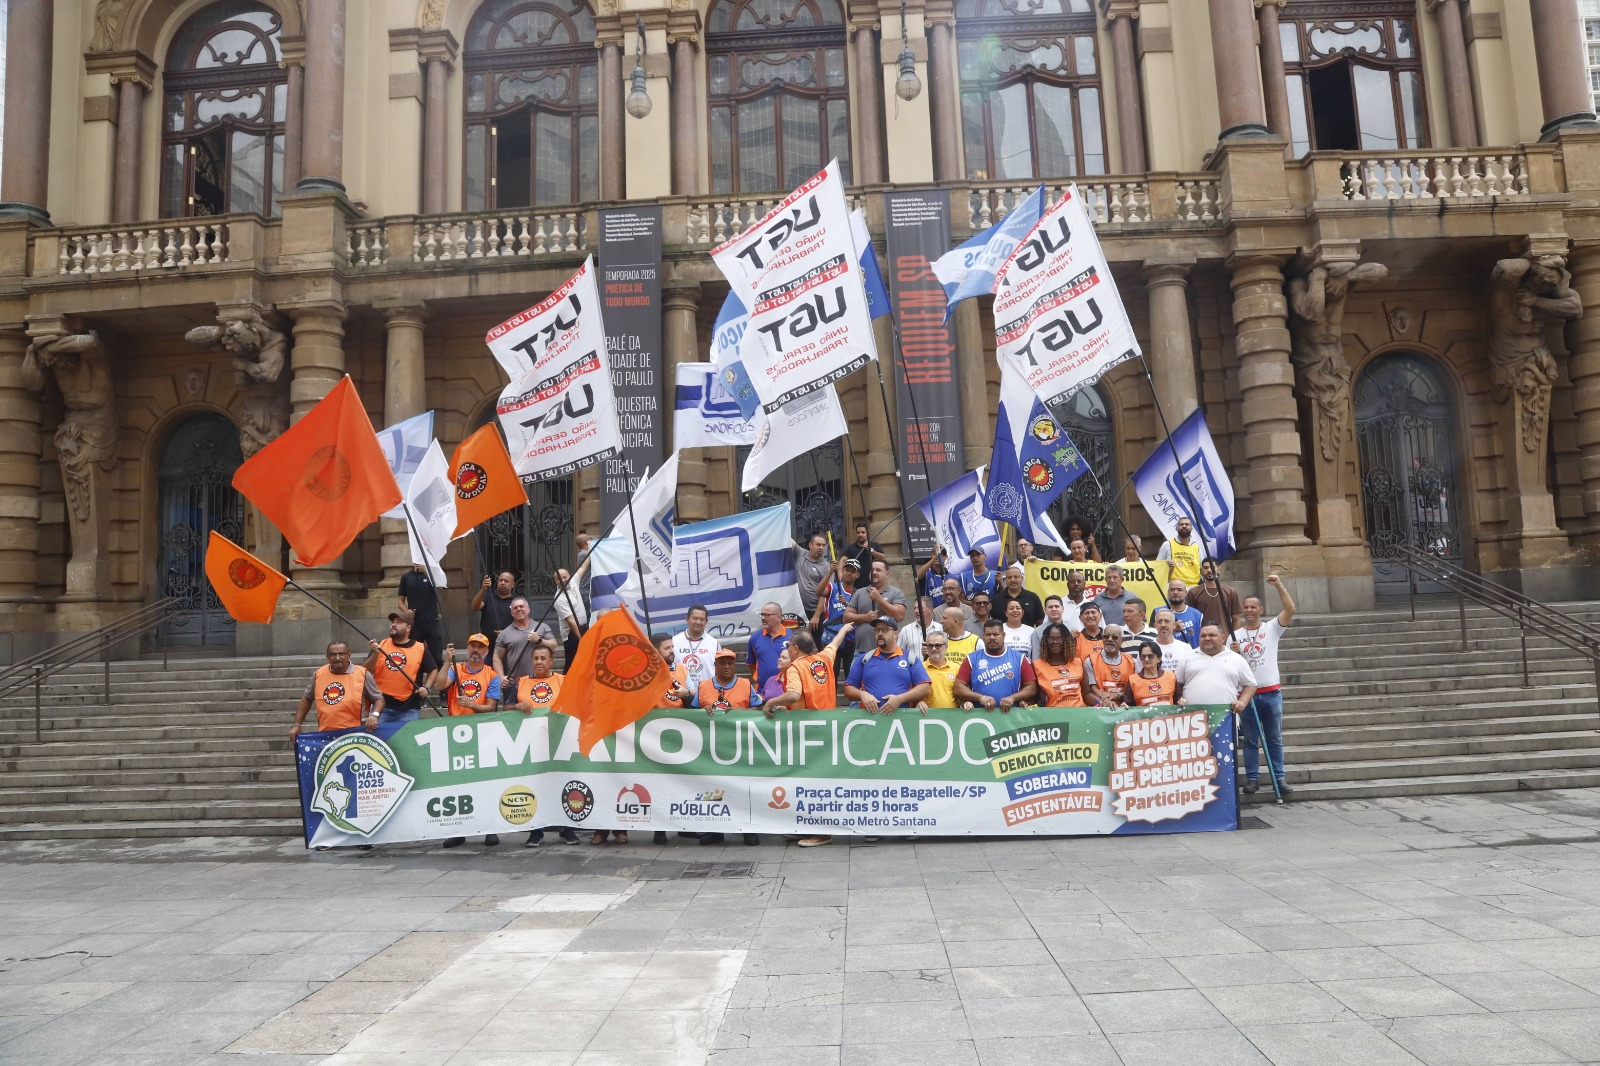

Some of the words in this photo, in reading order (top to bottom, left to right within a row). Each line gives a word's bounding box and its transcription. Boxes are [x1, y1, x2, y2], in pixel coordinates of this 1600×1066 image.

[605, 270, 640, 281] TEMPORADA
[641, 269, 655, 280] 2025
[605, 283, 633, 293] POÉTICA
[635, 283, 644, 293] DE
[606, 297, 623, 307] TODO
[624, 296, 650, 306] MUNDO
[605, 334, 626, 350] BALÉ
[629, 336, 641, 350] DA
[897, 290, 955, 384] RÉQUIEM
[640, 353, 651, 368] DE
[611, 370, 623, 386] ÃO
[625, 370, 653, 386] PAULO
[614, 396, 657, 413] RQUESTRA
[616, 413, 652, 430] FÔNICA
[930, 423, 940, 432] 20H
[620, 432, 653, 448] NICIPAL
[930, 444, 944, 452] MAR
[945, 443, 955, 451] 20H
[908, 455, 916, 463] 22
[932, 454, 946, 462] MAR
[1024, 458, 1042, 477] FORÇA
[1031, 468, 1053, 492] SINDICAL
[1040, 566, 1155, 581] COMRCRIOS
[978, 662, 1012, 682] QUÍMICOS
[1117, 713, 1206, 749] SHOWS
[453, 755, 475, 770] DE
[477, 716, 703, 769] MAIO
[710, 718, 996, 766] UNIFICADO
[990, 728, 1061, 754] SOLIDÁRIO
[368, 739, 394, 766] Trabalhadora
[998, 746, 1092, 774] DEMOCRÁTICO
[1116, 752, 1128, 770] E
[1133, 740, 1209, 767] SORTEIO
[358, 770, 384, 779] MAIO
[1111, 772, 1134, 790] DE
[1139, 758, 1216, 786] PRÊMIOS
[358, 779, 384, 788] 2025
[565, 782, 588, 795] FORÇA
[1014, 771, 1087, 795] SOBERANO
[796, 786, 832, 801] Praça
[835, 787, 879, 801] Campo
[882, 787, 898, 798] de
[900, 785, 987, 801] Bagatelle/SP
[1125, 786, 1206, 812] Participe!
[426, 795, 474, 817] CSB
[563, 802, 592, 820] SINDICAL
[616, 803, 651, 815] UGT
[670, 800, 731, 816] PÚBLICA
[796, 801, 805, 812] A
[808, 800, 843, 814] partir
[846, 801, 868, 812] das
[871, 801, 879, 812] 9
[882, 801, 918, 812] horas
[1006, 794, 1100, 823] SUSTENTÁVEL
[796, 815, 840, 826] Próximo
[842, 818, 855, 826] ao
[892, 816, 936, 826] Santana
